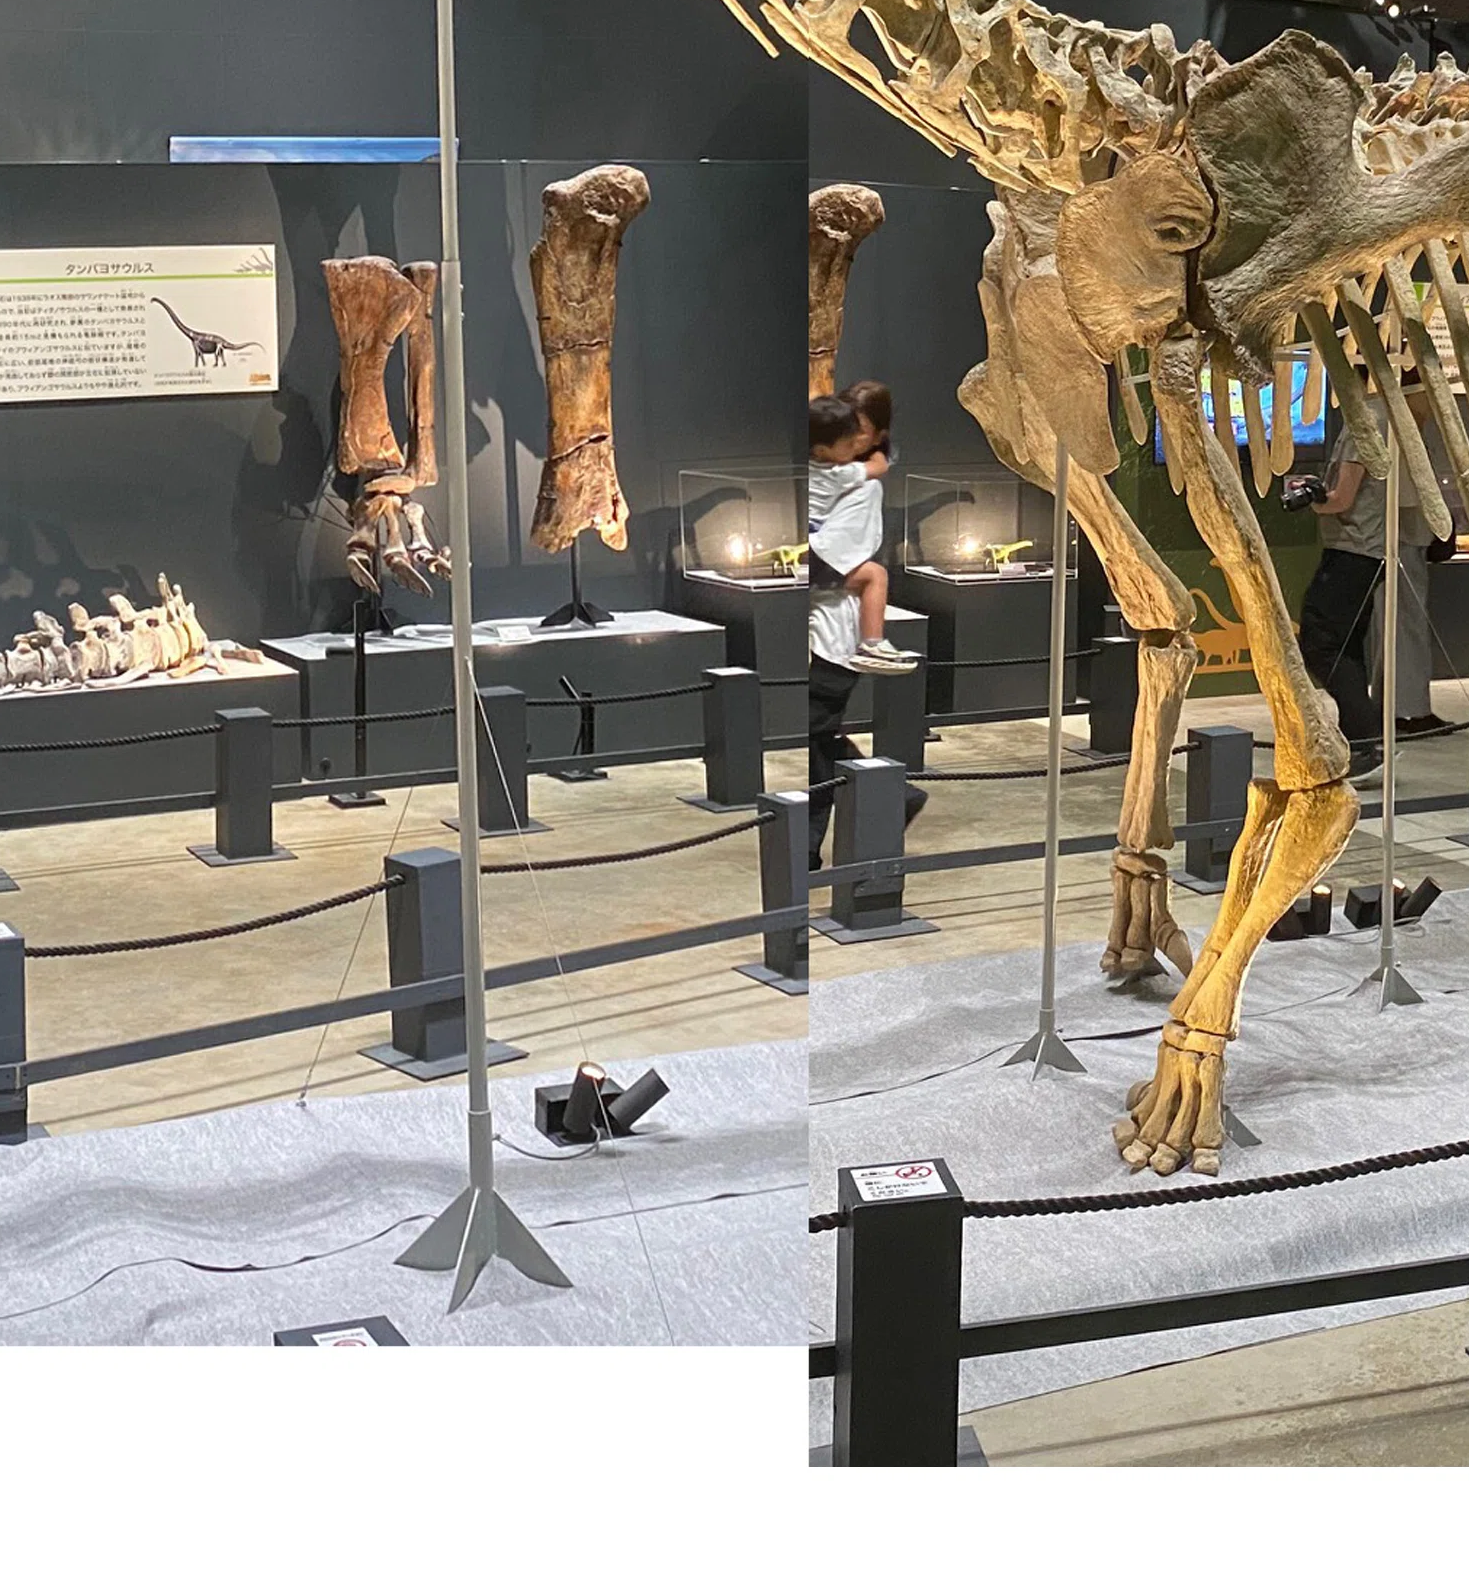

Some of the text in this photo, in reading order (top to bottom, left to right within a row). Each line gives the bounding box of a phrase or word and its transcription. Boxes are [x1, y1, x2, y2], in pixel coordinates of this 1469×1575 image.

[64, 262, 155, 276] タンバヨサウルス
